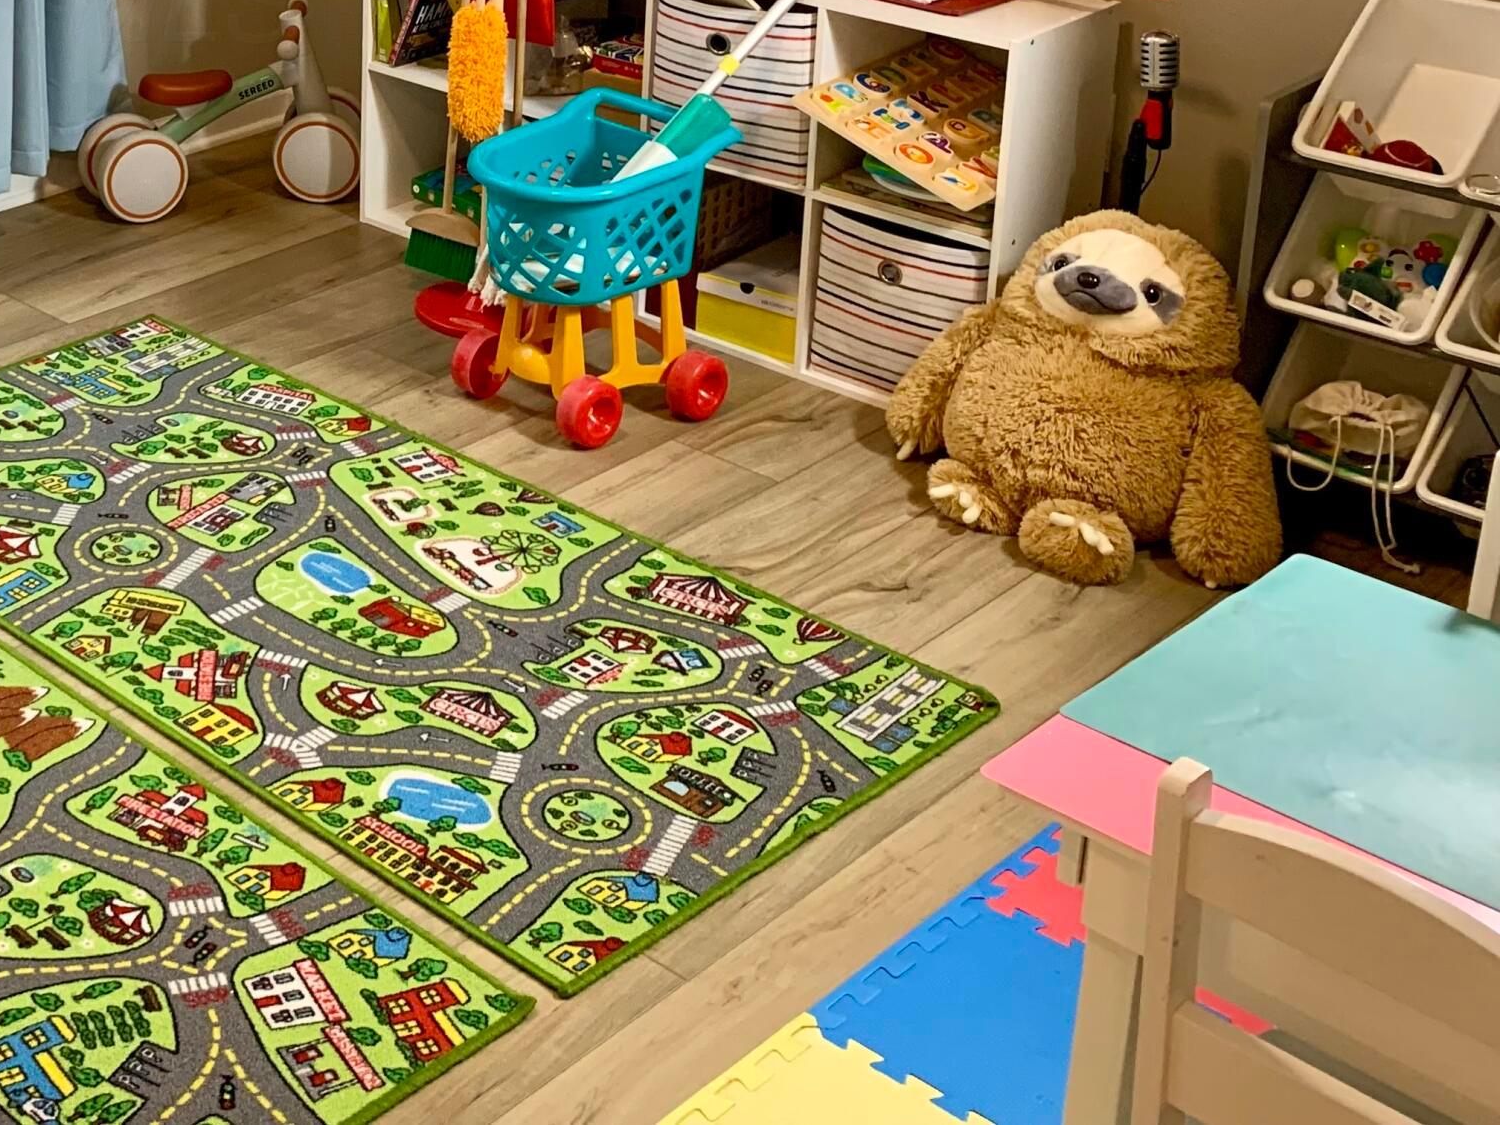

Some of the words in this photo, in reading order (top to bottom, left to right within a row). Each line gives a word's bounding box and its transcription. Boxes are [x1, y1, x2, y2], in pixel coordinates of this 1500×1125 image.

[238, 79, 275, 101] SEREED
[259, 383, 315, 402] HOSPITAL
[659, 587, 728, 615] CIRCUS
[429, 698, 502, 732] CIRCUS
[671, 764, 725, 795] COFFEE
[117, 795, 206, 837] FIRESTATION
[359, 816, 426, 857] SCHOOL
[297, 961, 347, 1021] MARKET
